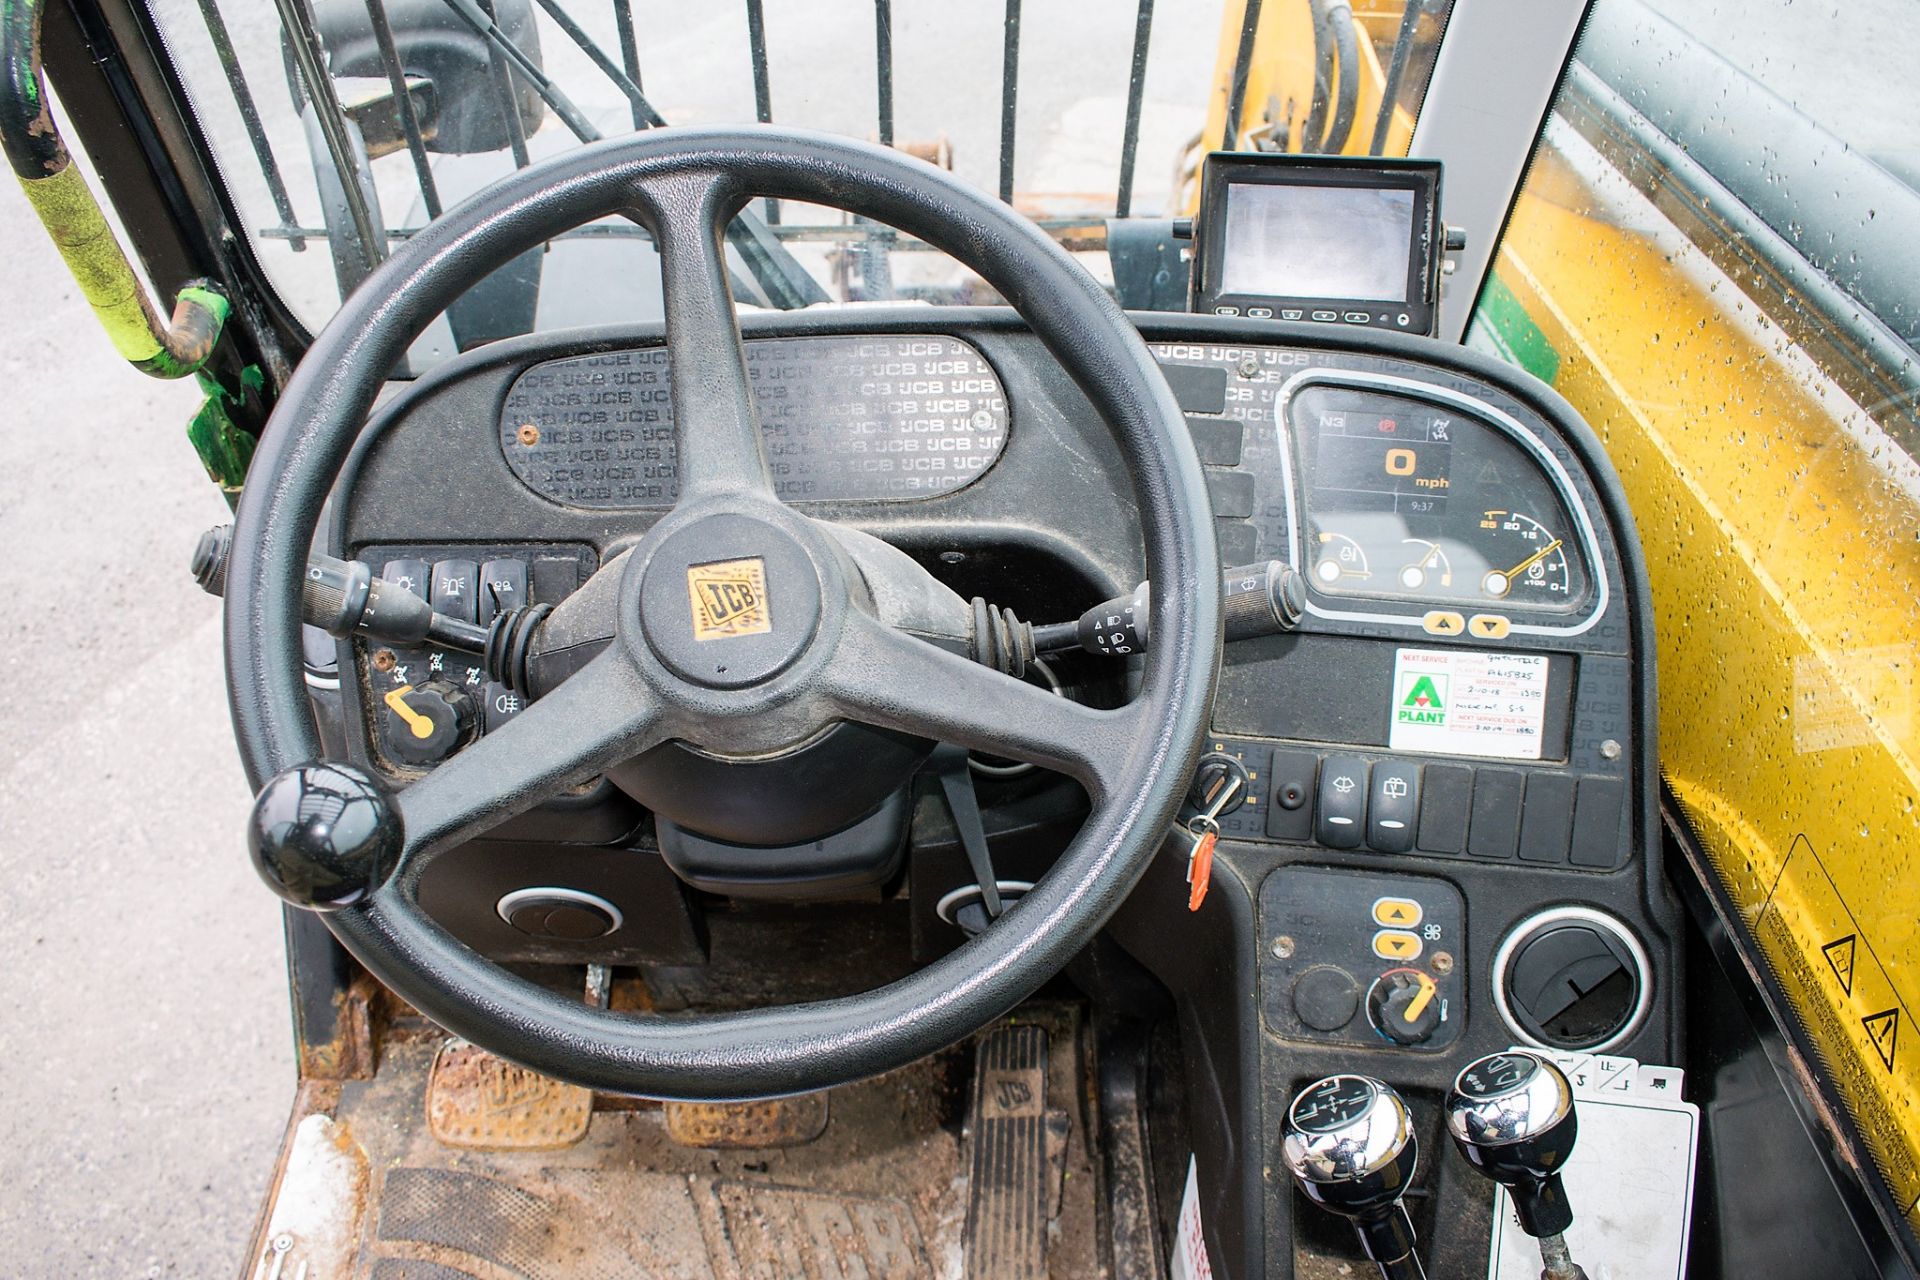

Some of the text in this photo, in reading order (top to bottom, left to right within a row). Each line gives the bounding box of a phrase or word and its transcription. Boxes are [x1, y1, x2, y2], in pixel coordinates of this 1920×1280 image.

[639, 351, 668, 365] JC
[897, 343, 942, 357] JCB
[1158, 345, 1205, 360] JCB
[1210, 347, 1257, 363] JCB
[1263, 350, 1310, 366] JCB
[614, 371, 657, 385] JCB
[873, 363, 917, 376] JCB
[924, 361, 969, 374] JCB
[590, 390, 633, 405] JCB
[641, 388, 671, 403] JC
[900, 381, 944, 395] JCB
[951, 379, 997, 393] JCB
[616, 408, 658, 423] JCB
[925, 399, 970, 413] JCB
[978, 398, 1004, 412] JC
[591, 429, 634, 443] JCB
[642, 427, 673, 442] JC
[900, 419, 945, 433] JCB
[1320, 416, 1344, 427] N3
[617, 447, 661, 462] JCB
[927, 436, 971, 450] JCB
[592, 466, 636, 481] JCB
[902, 457, 945, 471] JCB
[1385, 448, 1449, 489] 0 mph
[618, 484, 662, 499] JCB
[1411, 501, 1434, 511] 9:37
[1480, 520, 1520, 531] 25 20
[1521, 531, 1537, 539] 15
[1548, 563, 1557, 571] 5
[365, 608, 375, 616] 2
[706, 583, 755, 620] JCB
[1403, 654, 1448, 664] NEXT SERVICE
[1403, 676, 1443, 707] A
[1399, 710, 1445, 723] PLANT
